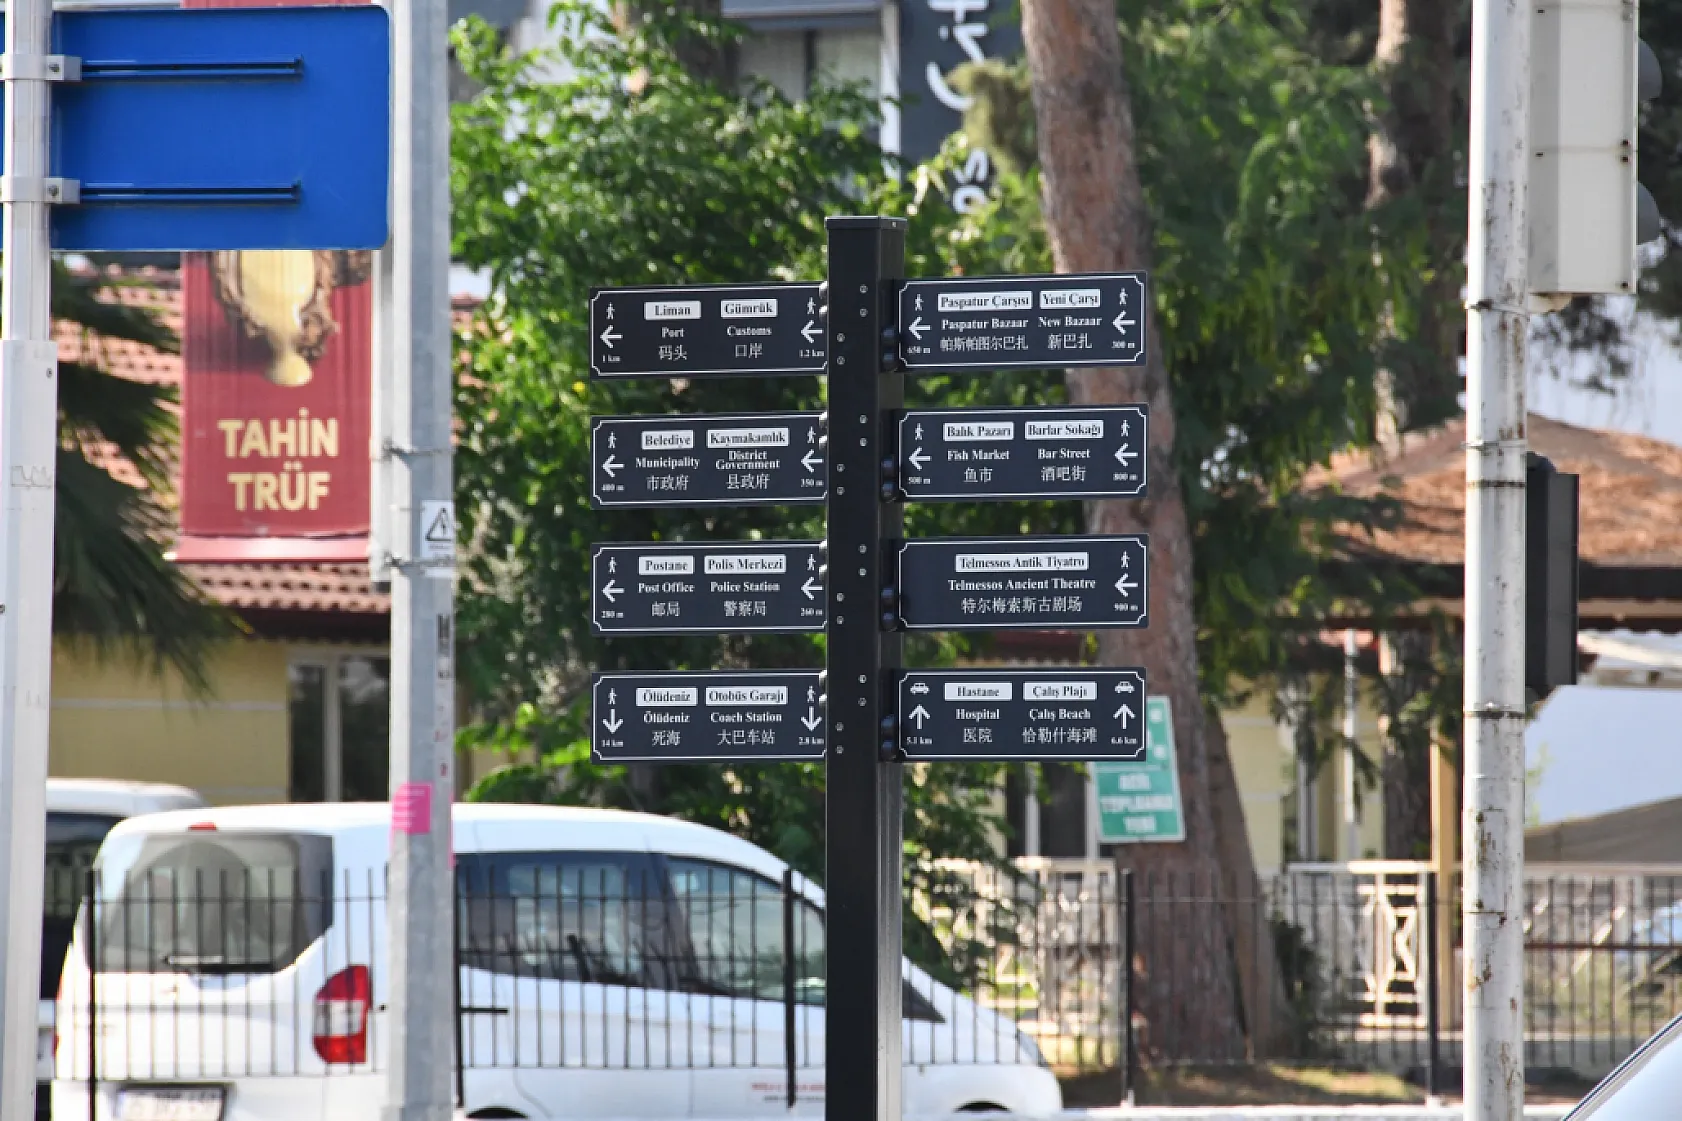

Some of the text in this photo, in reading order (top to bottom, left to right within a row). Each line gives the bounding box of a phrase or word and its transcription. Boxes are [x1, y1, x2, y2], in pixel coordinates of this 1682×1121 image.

[941, 296, 1028, 309] Paspatur Çarşısı
[1042, 293, 1097, 306] Yeni Çarşı
[655, 305, 691, 316] Liman
[724, 302, 773, 314] Gümrük
[941, 318, 1028, 332] Paspatur Bazaar
[1038, 316, 1102, 327] New Bazaar
[661, 327, 685, 338] Port
[727, 326, 772, 336] Customs
[1048, 333, 1092, 349] 新巴扎
[658, 345, 687, 360] 码头
[735, 343, 763, 358] 口岸
[812, 349, 824, 357] km
[217, 406, 340, 458] TAHİN
[947, 426, 1010, 436] Balık Pazarı
[1028, 424, 1101, 437] Barlar Sokağı
[645, 435, 691, 448] Belediye
[710, 431, 785, 446] Kaymakamlık
[729, 451, 767, 460] District
[948, 449, 1010, 460] Fish Market
[1038, 448, 1090, 459] Bar Street
[636, 457, 700, 469] Municipality
[715, 459, 780, 470] Government
[964, 467, 993, 483] 鱼市
[1041, 466, 1086, 482] 酒吧街
[227, 459, 331, 512] TRÜF
[647, 475, 689, 491] 市政府
[726, 474, 770, 490] 县政府
[645, 561, 688, 571] Postane
[708, 559, 783, 569] Polis Merkezi
[960, 556, 1084, 569] Telmessos Antik Tiyatro
[638, 582, 695, 593] Post Office
[710, 581, 780, 592] Police Station
[948, 578, 1096, 591] Telmessos Ancient Theatre
[651, 601, 680, 617] 邮局
[723, 600, 766, 617] 警察局
[961, 596, 1083, 613] 特尔梅索斯古剧场
[643, 690, 690, 702] Ölüdeniz
[709, 690, 783, 702] Otobüs Garajı
[957, 687, 999, 696] Hastane
[1033, 686, 1087, 698] Çalış Plajı
[644, 711, 690, 723] Ölüdeniz
[710, 712, 781, 722] Coach Station
[955, 709, 999, 722] Hospital
[1030, 709, 1090, 721] Çalış Beach
[652, 730, 680, 746] 死海
[717, 729, 775, 746] 大巴车站
[964, 728, 992, 743] 医院
[1023, 727, 1097, 744] 恰勒什海滩
